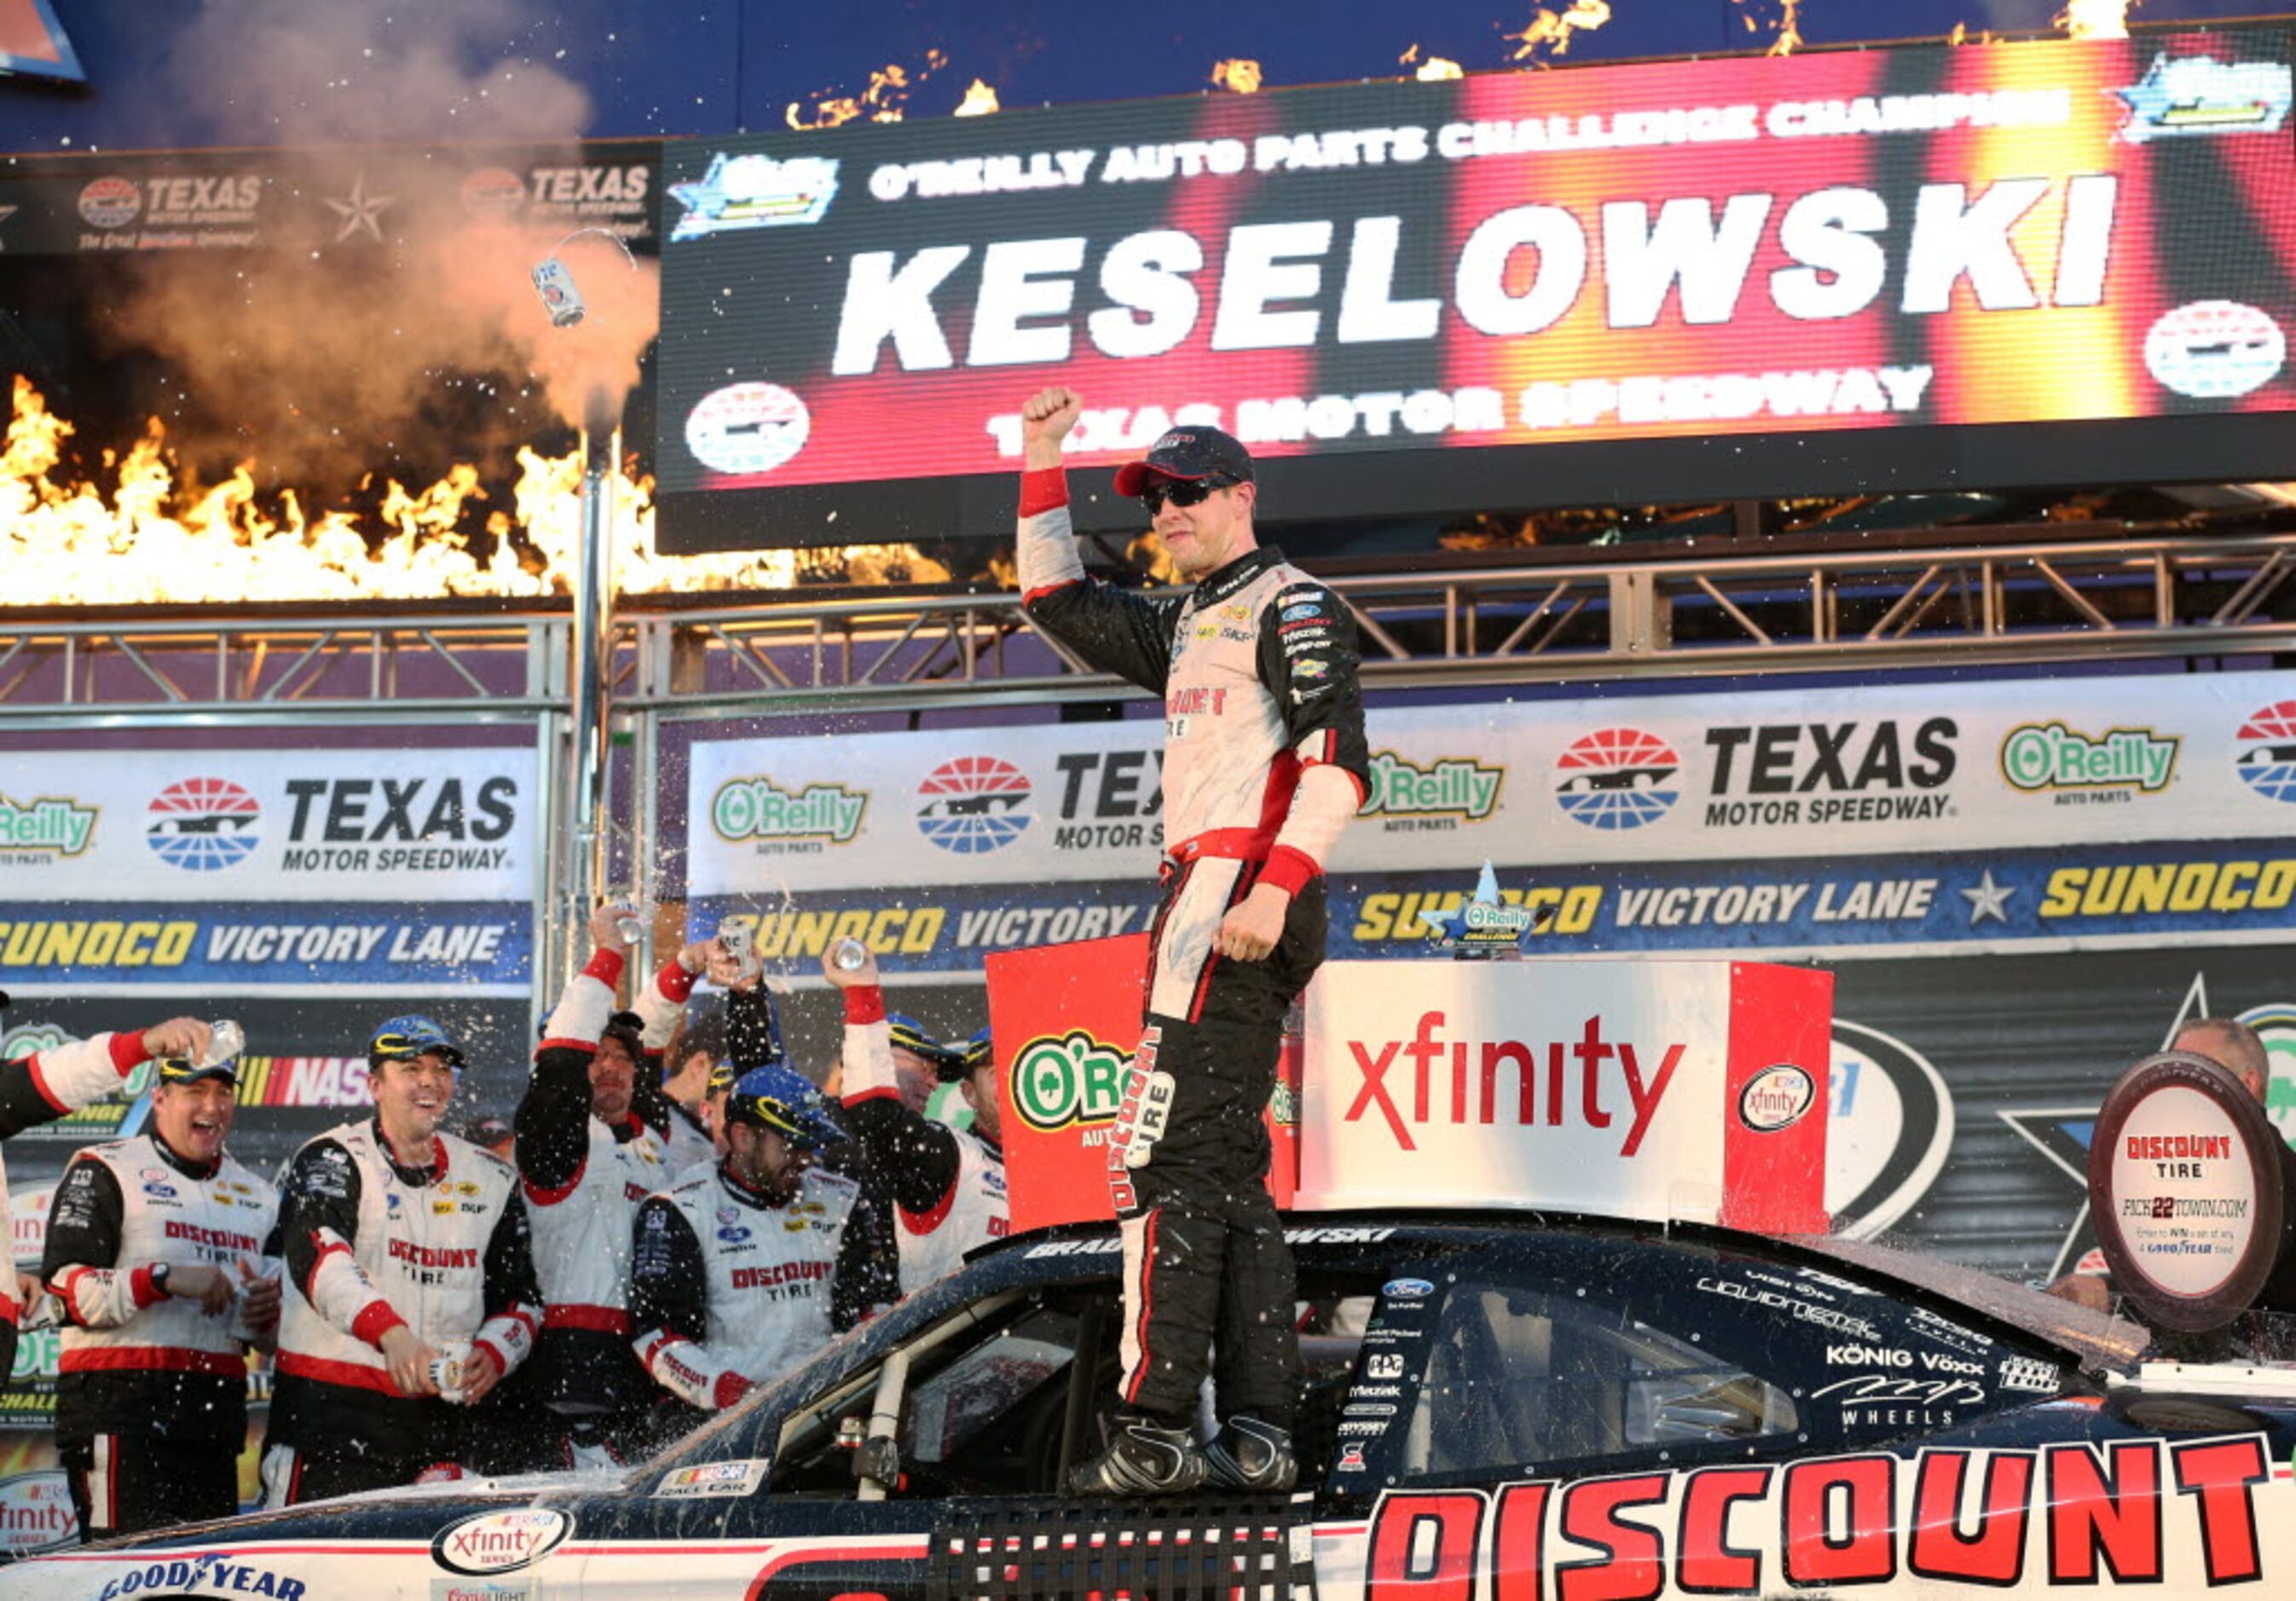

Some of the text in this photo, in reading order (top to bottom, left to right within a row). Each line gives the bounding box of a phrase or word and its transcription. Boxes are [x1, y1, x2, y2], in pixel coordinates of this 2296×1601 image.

[869, 147, 1095, 200] O'REILLY
[1102, 139, 1246, 182] AUTO
[1254, 124, 1429, 170] PARTS
[1437, 105, 1759, 159] CHALLENGE
[147, 176, 262, 211] TEXAS
[531, 165, 650, 201] TEXAS
[832, 175, 2117, 376] KESELOWSKI
[986, 365, 1934, 456] TXAS MOTOR SPEEDWAY
[1706, 717, 1959, 794] TEXAS
[2009, 728, 2171, 783] O'Reilly
[285, 777, 518, 842] TEXAS
[718, 782, 863, 839] O'Reilly
[1706, 795, 1950, 827] MOTOR SPEEDWAY
[2054, 789, 2131, 806] AUTO PARTS
[1055, 826, 1144, 849] MOTOR
[1384, 818, 1456, 832] AUTO PARTS
[282, 849, 506, 871] MOTOR SPEEDWAY
[756, 841, 823, 853] AUTO PARTS
[1616, 879, 1938, 927] VICTORY LANE
[2039, 859, 2296, 917] SUNOCO
[957, 905, 1137, 946] VICTORY
[1353, 887, 1604, 939] SUCO
[206, 926, 385, 962] VICTORY
[388, 926, 506, 962] LANE
[1345, 1011, 1686, 1157] xfinity
[1130, 1083, 1169, 1155] IRE
[2127, 1134, 2231, 1160] DISCOUNT
[2157, 1163, 2203, 1179] TIRE
[165, 1220, 259, 1254] DISCOUNT
[2170, 1228, 2189, 1238] WIN
[194, 1245, 239, 1264] TIRE
[402, 1265, 444, 1285] TIRE
[768, 1283, 813, 1302] TIRE
[1826, 1343, 1914, 1367] KÖNIG
[1350, 1384, 1401, 1397] Mazak
[1842, 1409, 1953, 1425] WHEELS
[1366, 1432, 2270, 1601] DISCOUNT
[453, 1527, 544, 1558] xfinity
